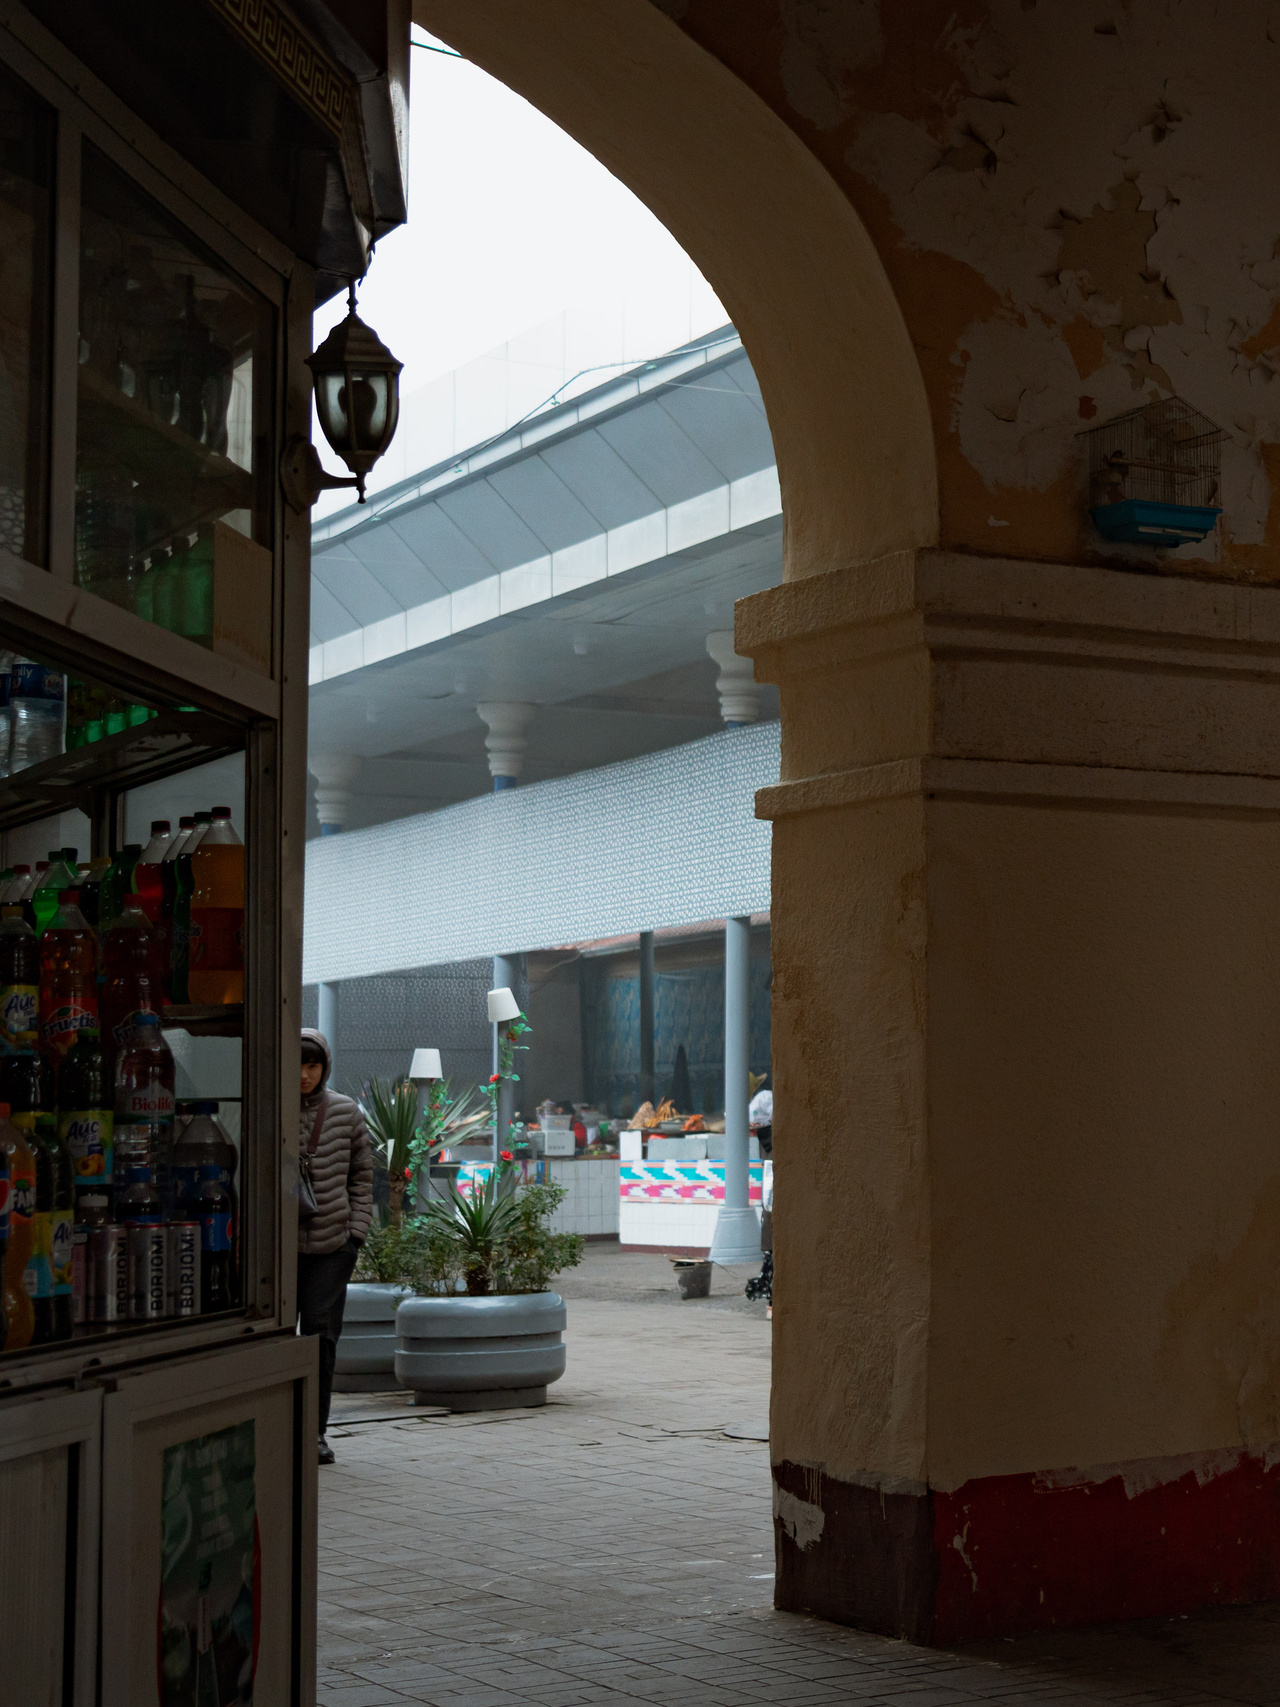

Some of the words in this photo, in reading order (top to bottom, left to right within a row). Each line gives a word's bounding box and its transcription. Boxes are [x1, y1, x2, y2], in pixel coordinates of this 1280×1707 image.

[41, 1012, 96, 1042] Fructis
[132, 1097, 174, 1112] Biolife
[116, 1236, 128, 1315] BORJOMI
[150, 1234, 164, 1312] BORJOMI
[180, 1232, 195, 1308] BORJOMI
